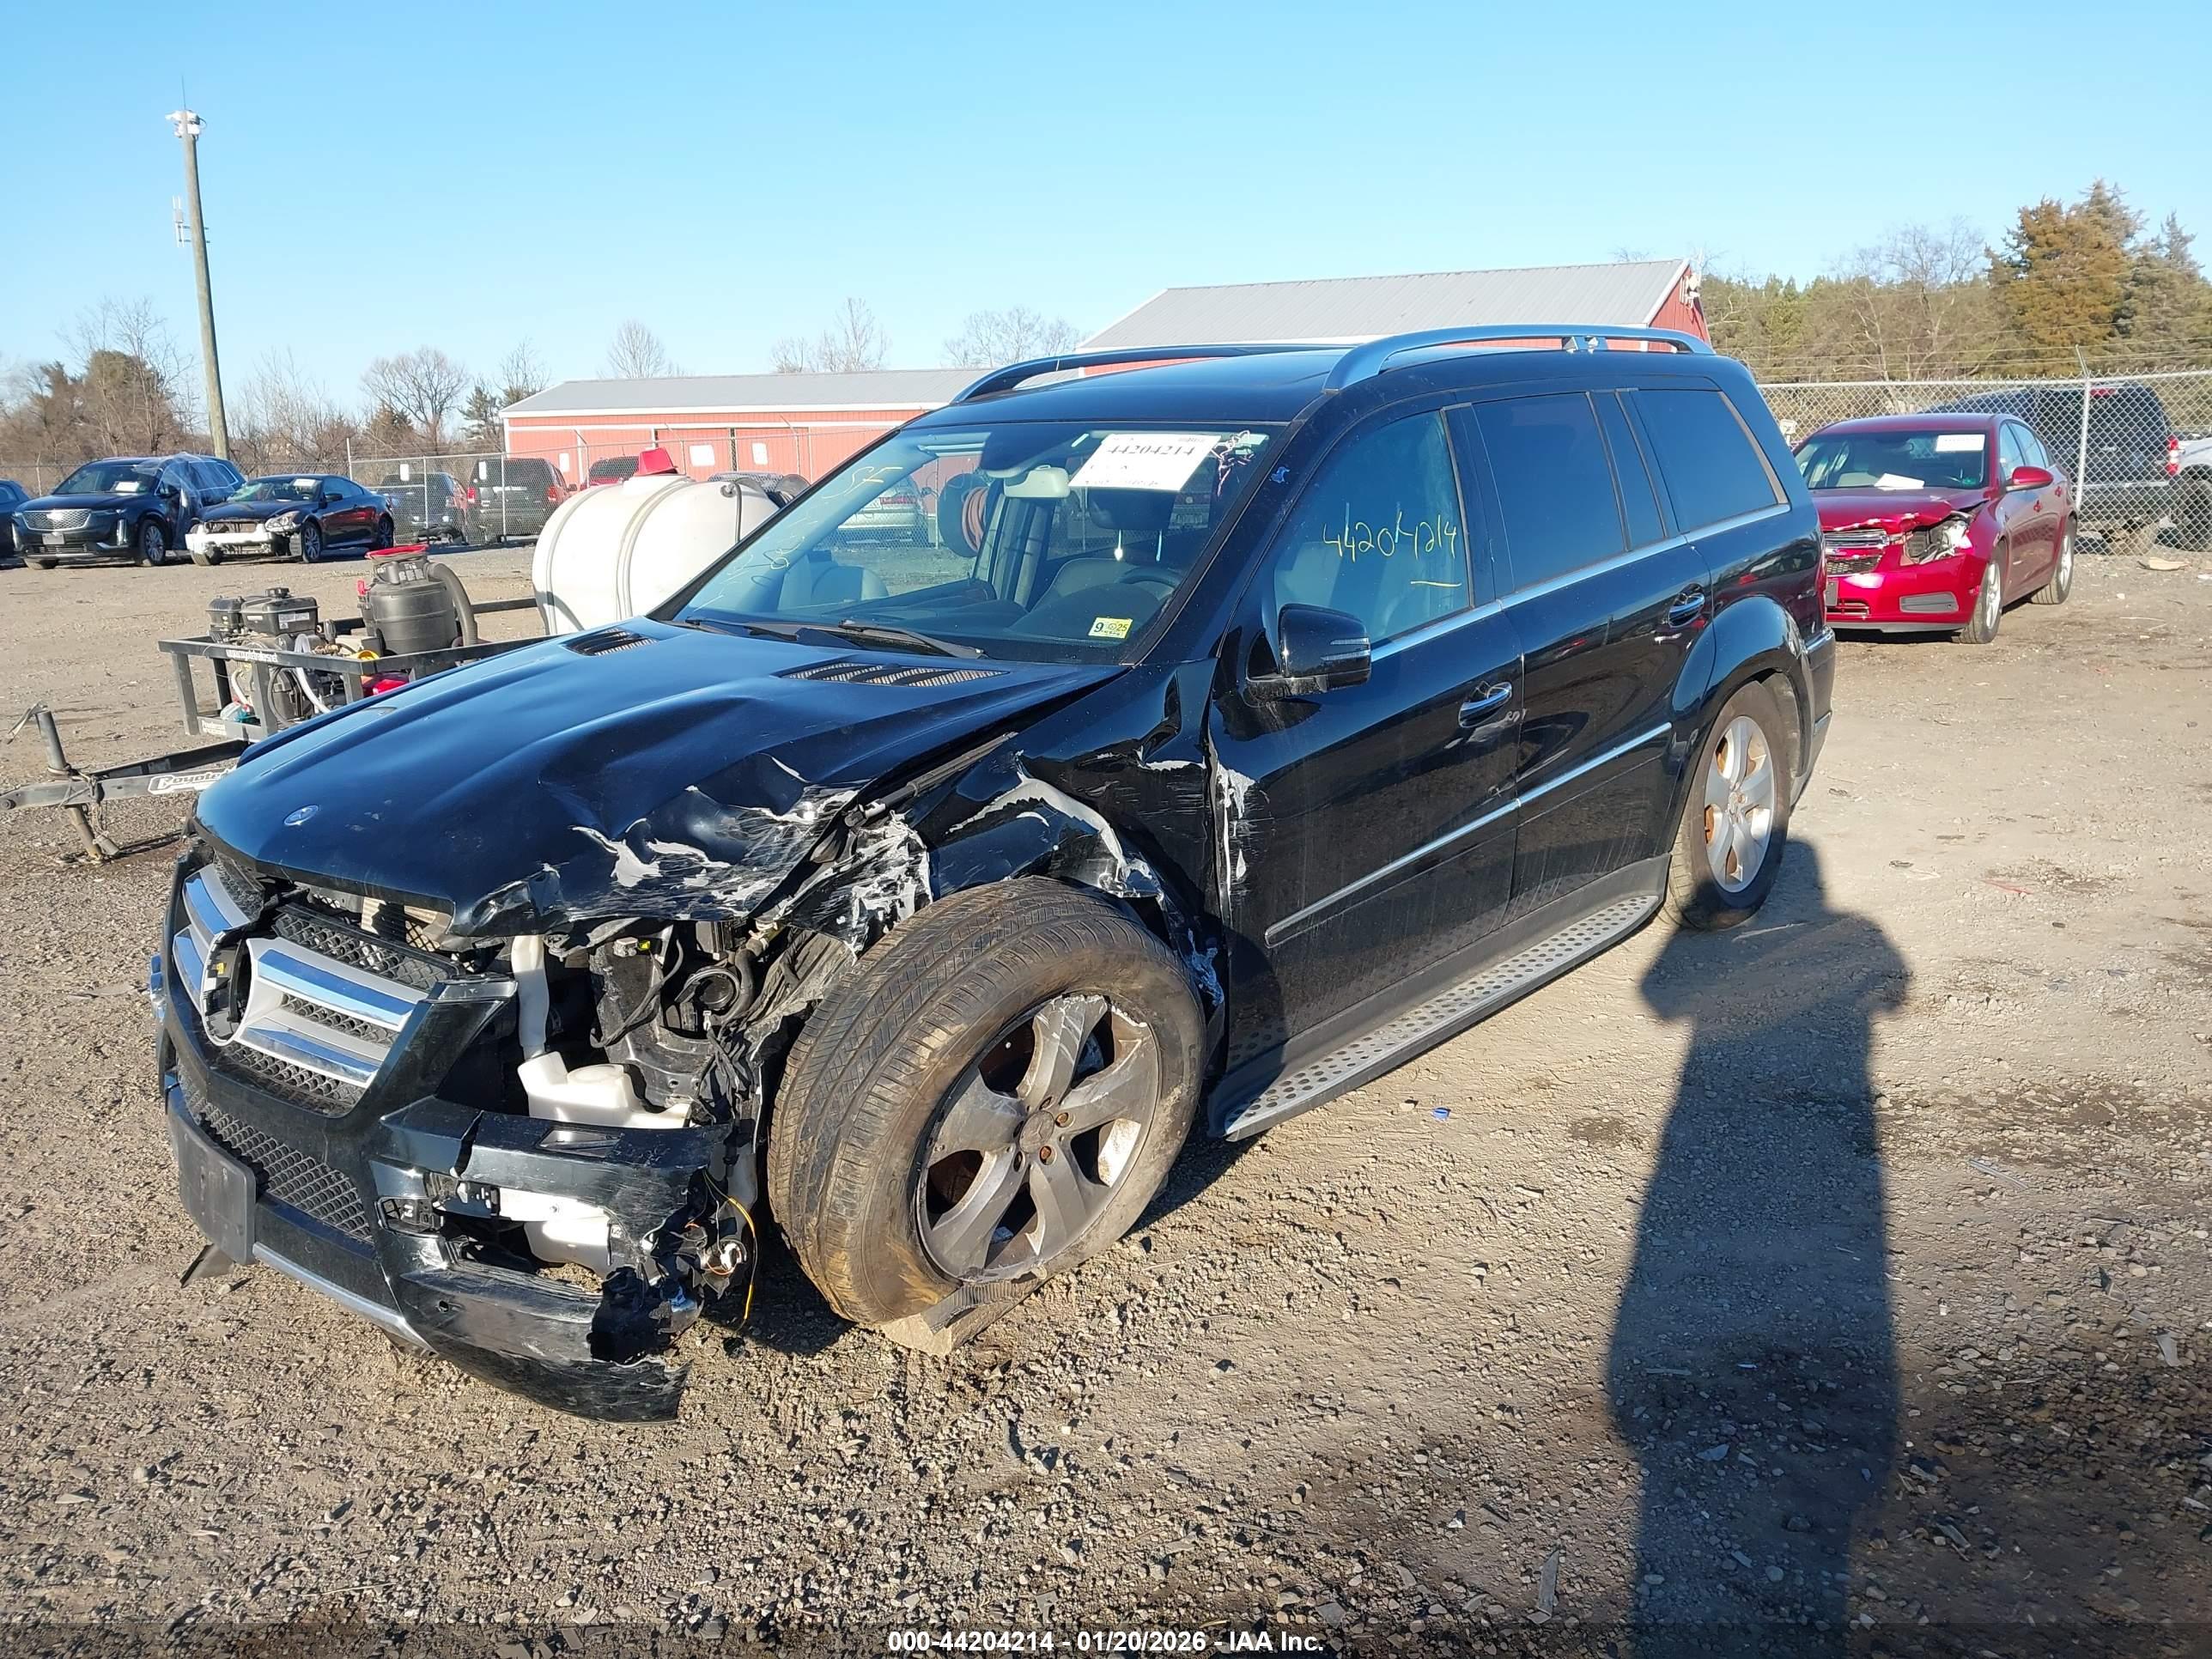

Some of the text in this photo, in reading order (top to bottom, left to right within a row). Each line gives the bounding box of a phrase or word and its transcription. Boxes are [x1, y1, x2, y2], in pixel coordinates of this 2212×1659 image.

[1107, 444, 1195, 456] 44204214
[1094, 622, 1129, 633] 9 25
[148, 771, 221, 791] Coyote
